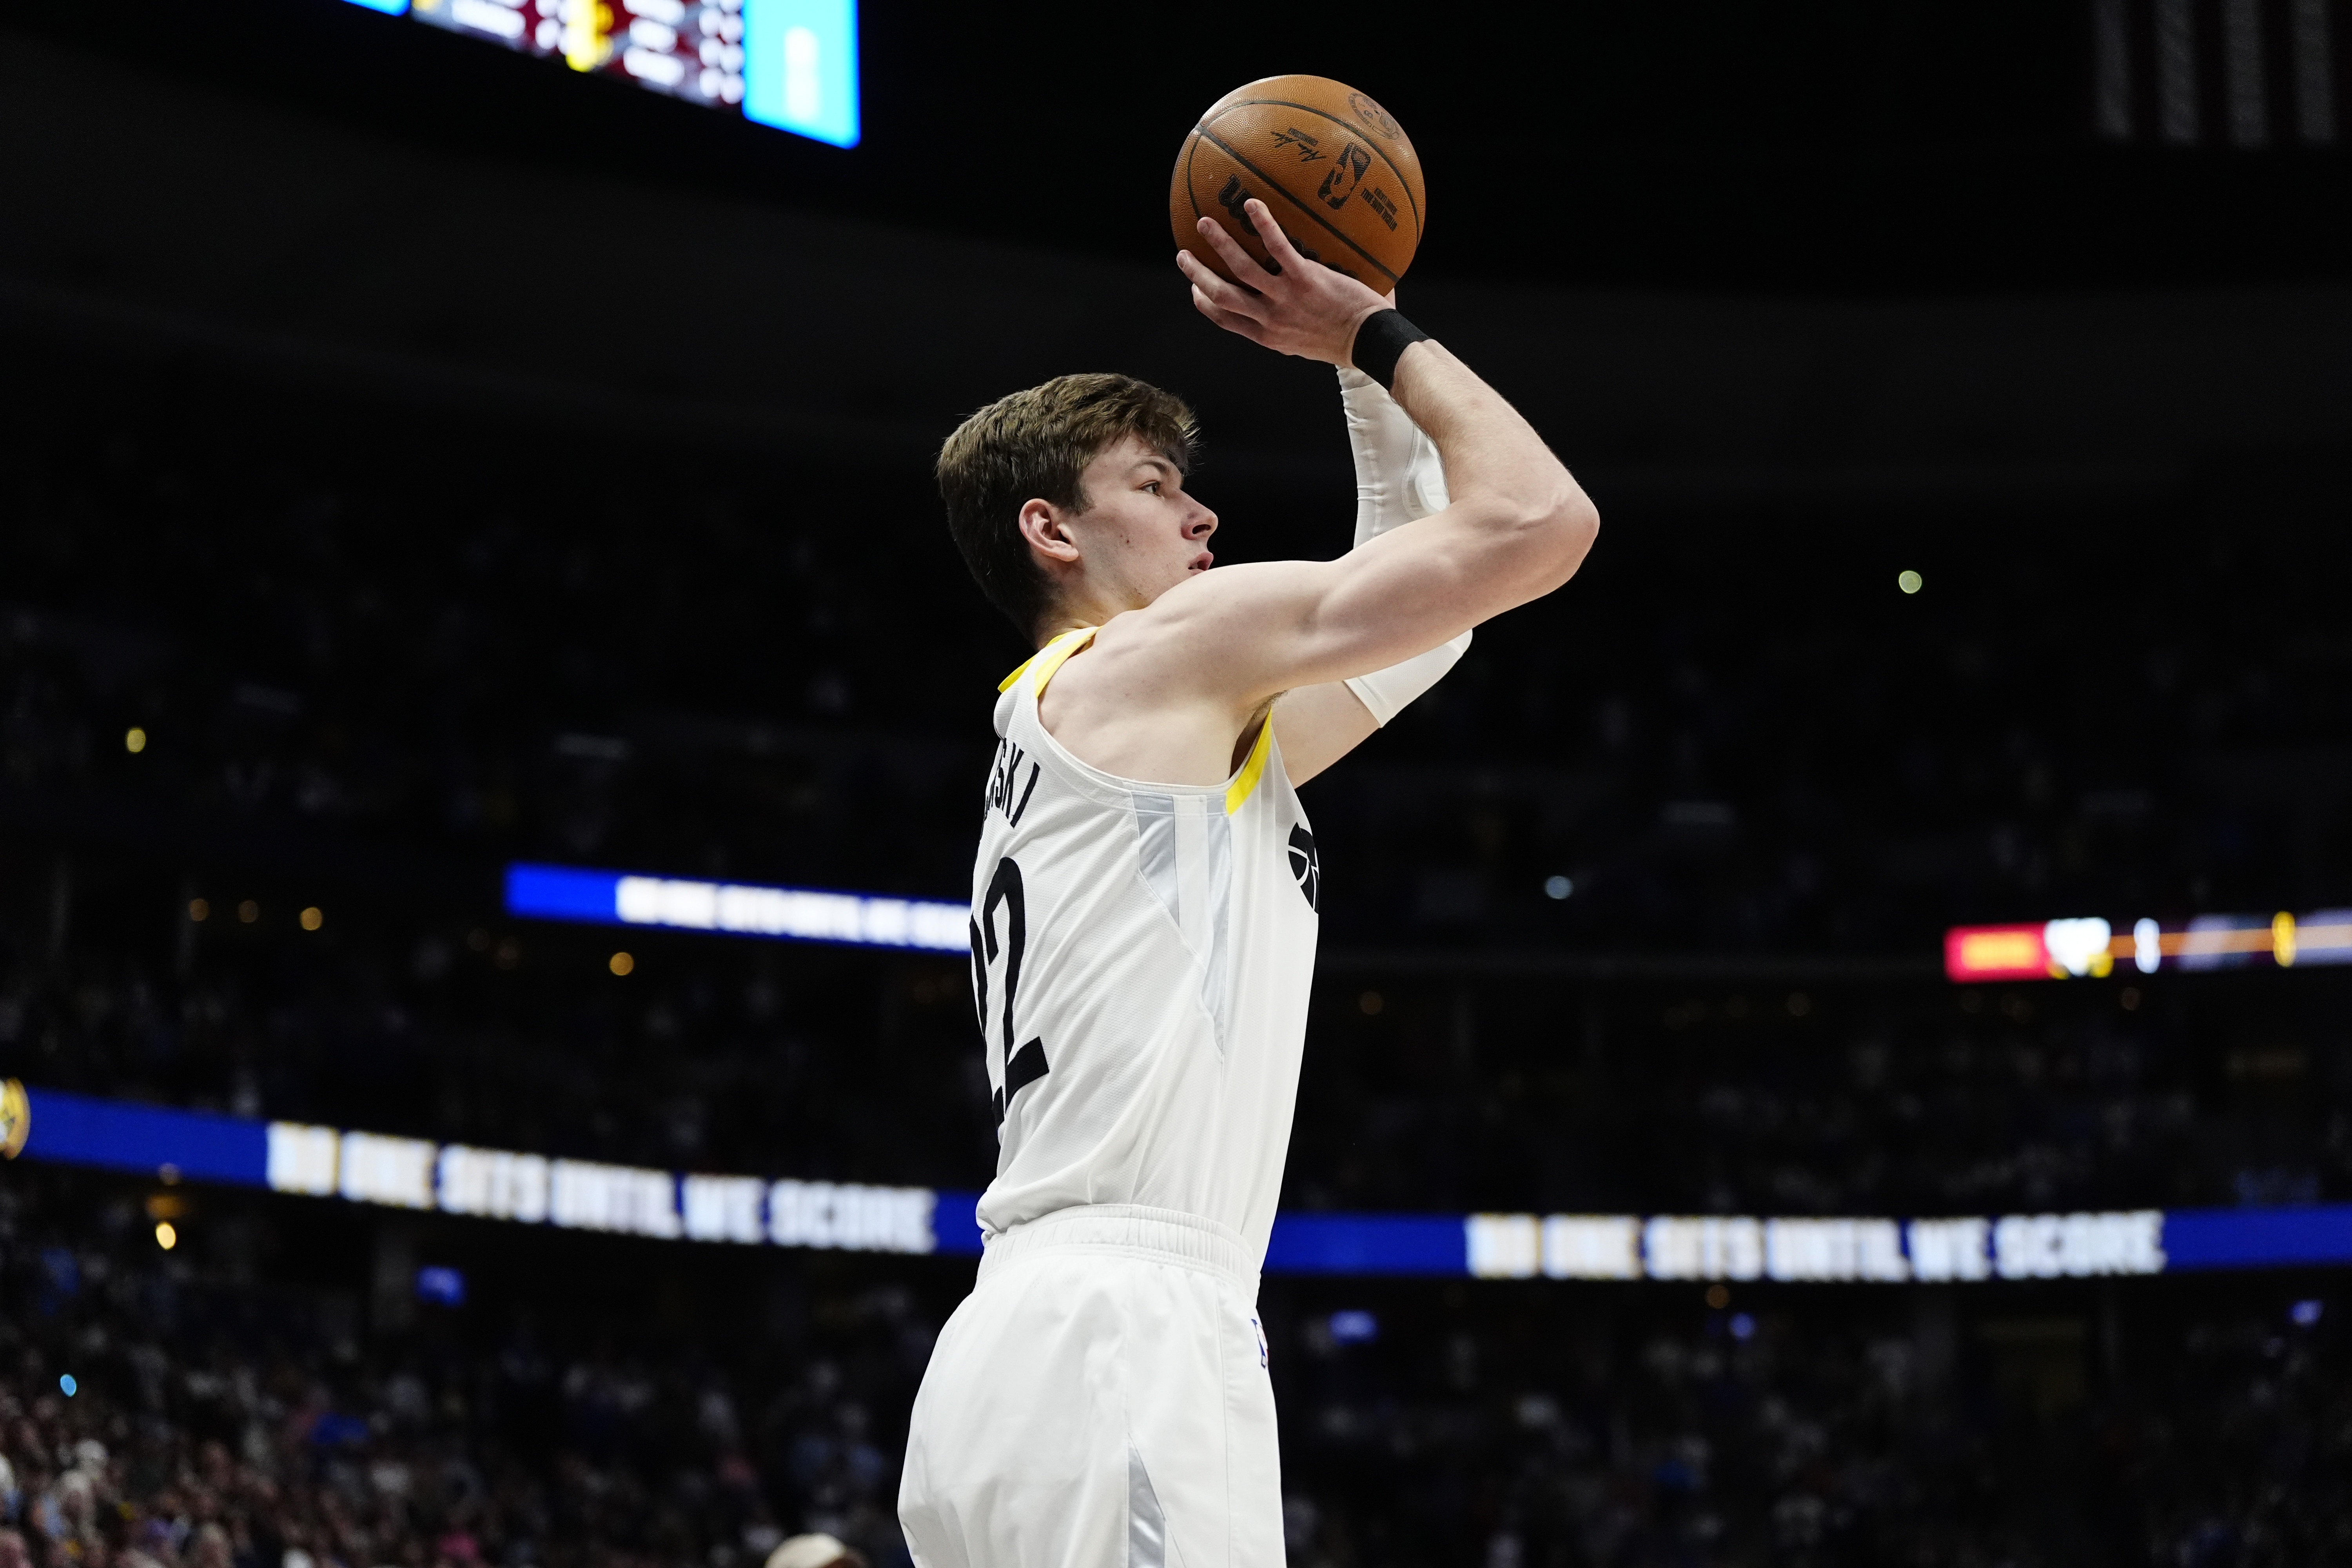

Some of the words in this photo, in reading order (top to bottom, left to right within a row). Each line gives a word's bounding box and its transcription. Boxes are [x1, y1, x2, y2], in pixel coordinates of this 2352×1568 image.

[1287, 127, 1318, 147] COMMISSIONER
[769, 1181, 933, 1253] SCORE
[1994, 1210, 2164, 1277] SCORE
